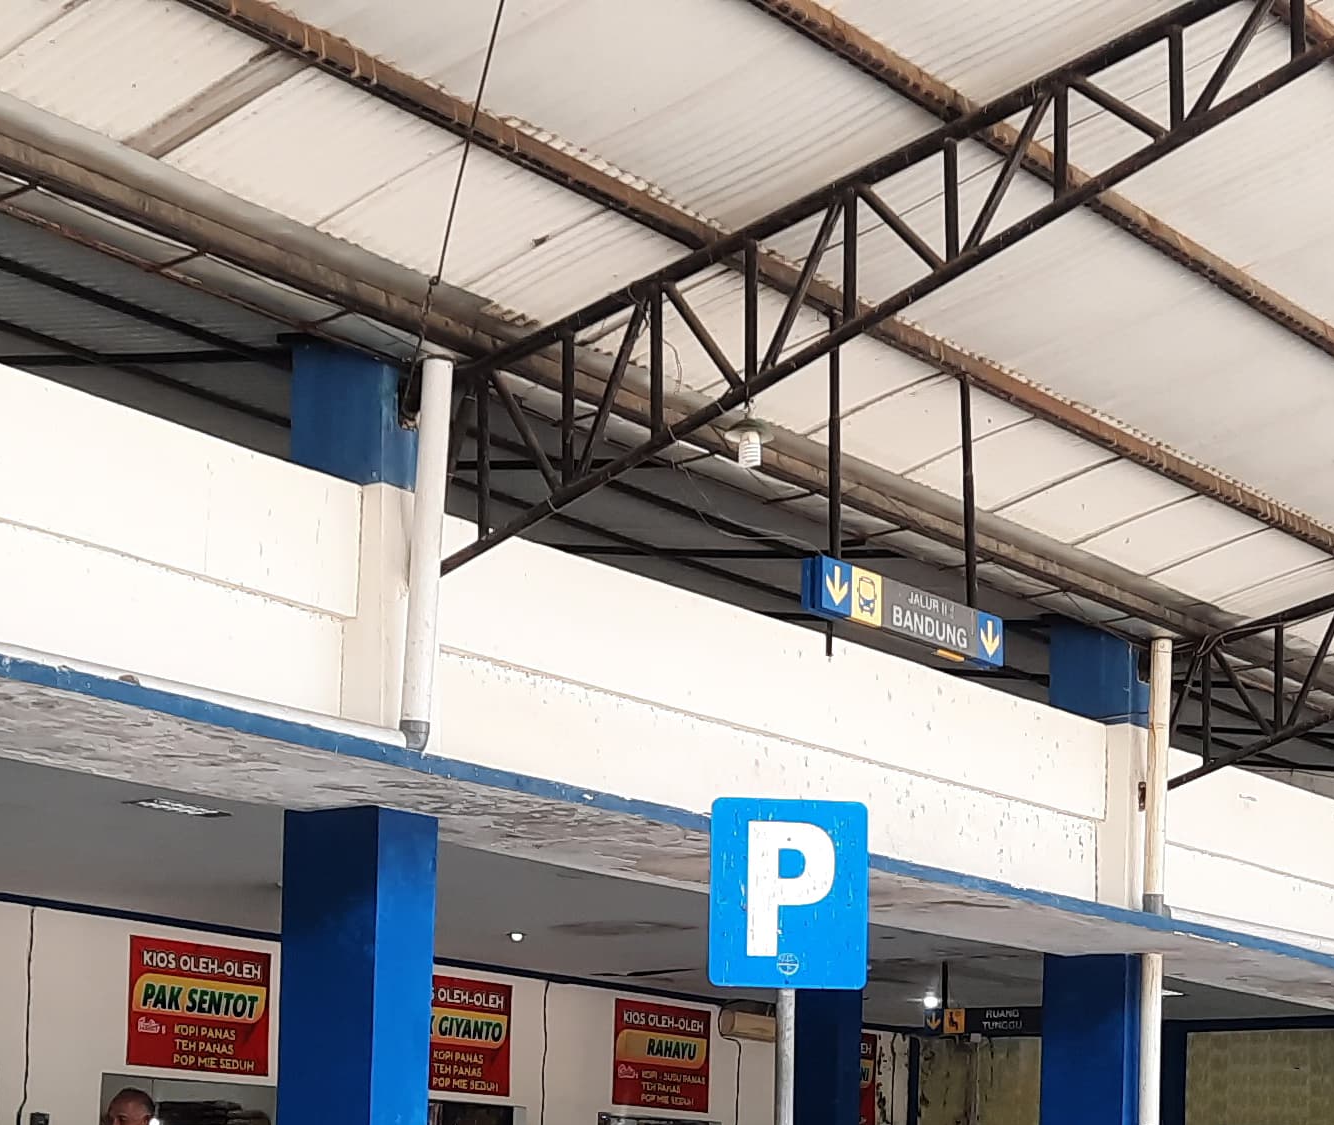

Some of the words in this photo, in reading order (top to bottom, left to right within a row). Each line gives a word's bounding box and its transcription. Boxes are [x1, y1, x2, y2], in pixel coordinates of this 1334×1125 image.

[908, 592, 939, 613] JALUR
[892, 605, 967, 648] BANDUNG
[746, 820, 835, 957] P
[142, 950, 176, 969] KIOS
[179, 954, 262, 980] OLEH-OLEH
[141, 982, 183, 1011] PAK
[186, 988, 259, 1020] SENTOT
[437, 987, 504, 1009] OLEH-OLEH
[174, 1023, 199, 1036] KOPI
[201, 1027, 236, 1040] PANAS
[438, 1015, 503, 1042] GIYANTO
[623, 1010, 645, 1025] KIOS
[648, 1014, 704, 1032] OLEH-OLEH
[174, 1039, 197, 1051] TEH
[198, 1042, 234, 1055] PANAS
[647, 1039, 696, 1060] RAHAYU
[173, 1053, 196, 1065] POP
[198, 1056, 218, 1068] MIE
[220, 1058, 255, 1072] SEDUH
[433, 1063, 451, 1075] TEH
